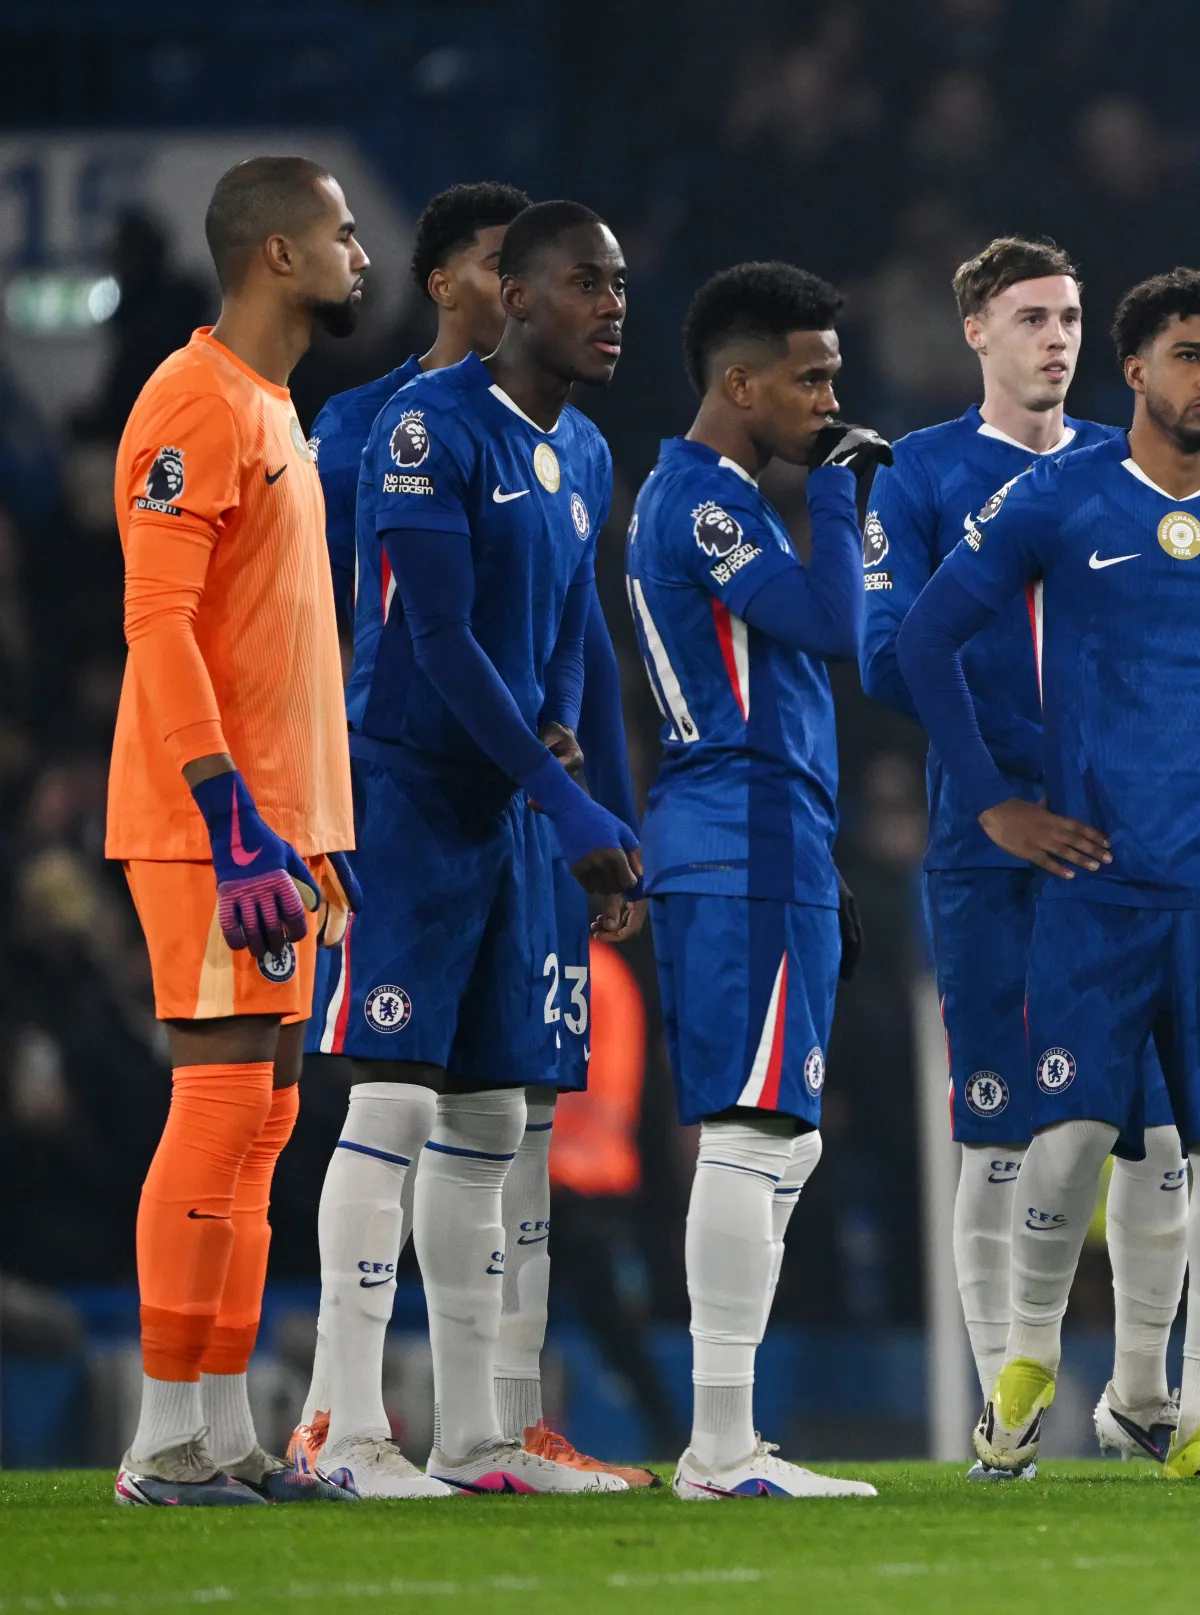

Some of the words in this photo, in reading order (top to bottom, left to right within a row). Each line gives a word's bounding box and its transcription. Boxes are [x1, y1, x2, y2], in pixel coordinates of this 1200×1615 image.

[384, 473, 399, 484] No
[400, 475, 429, 486] room
[383, 482, 398, 493] for
[398, 484, 434, 495] racism
[146, 500, 177, 514] room
[1173, 547, 1191, 556] FIFA
[710, 563, 727, 578] No
[725, 543, 754, 566] room
[730, 547, 763, 574] racism
[864, 572, 888, 582] oom
[864, 581, 893, 591] acism
[373, 986, 404, 998] CHELSEA
[1042, 1049, 1068, 1061] CHELSEA
[1164, 1168, 1187, 1181] CF
[1028, 1207, 1067, 1222] CFC
[358, 1261, 394, 1274] CFC
